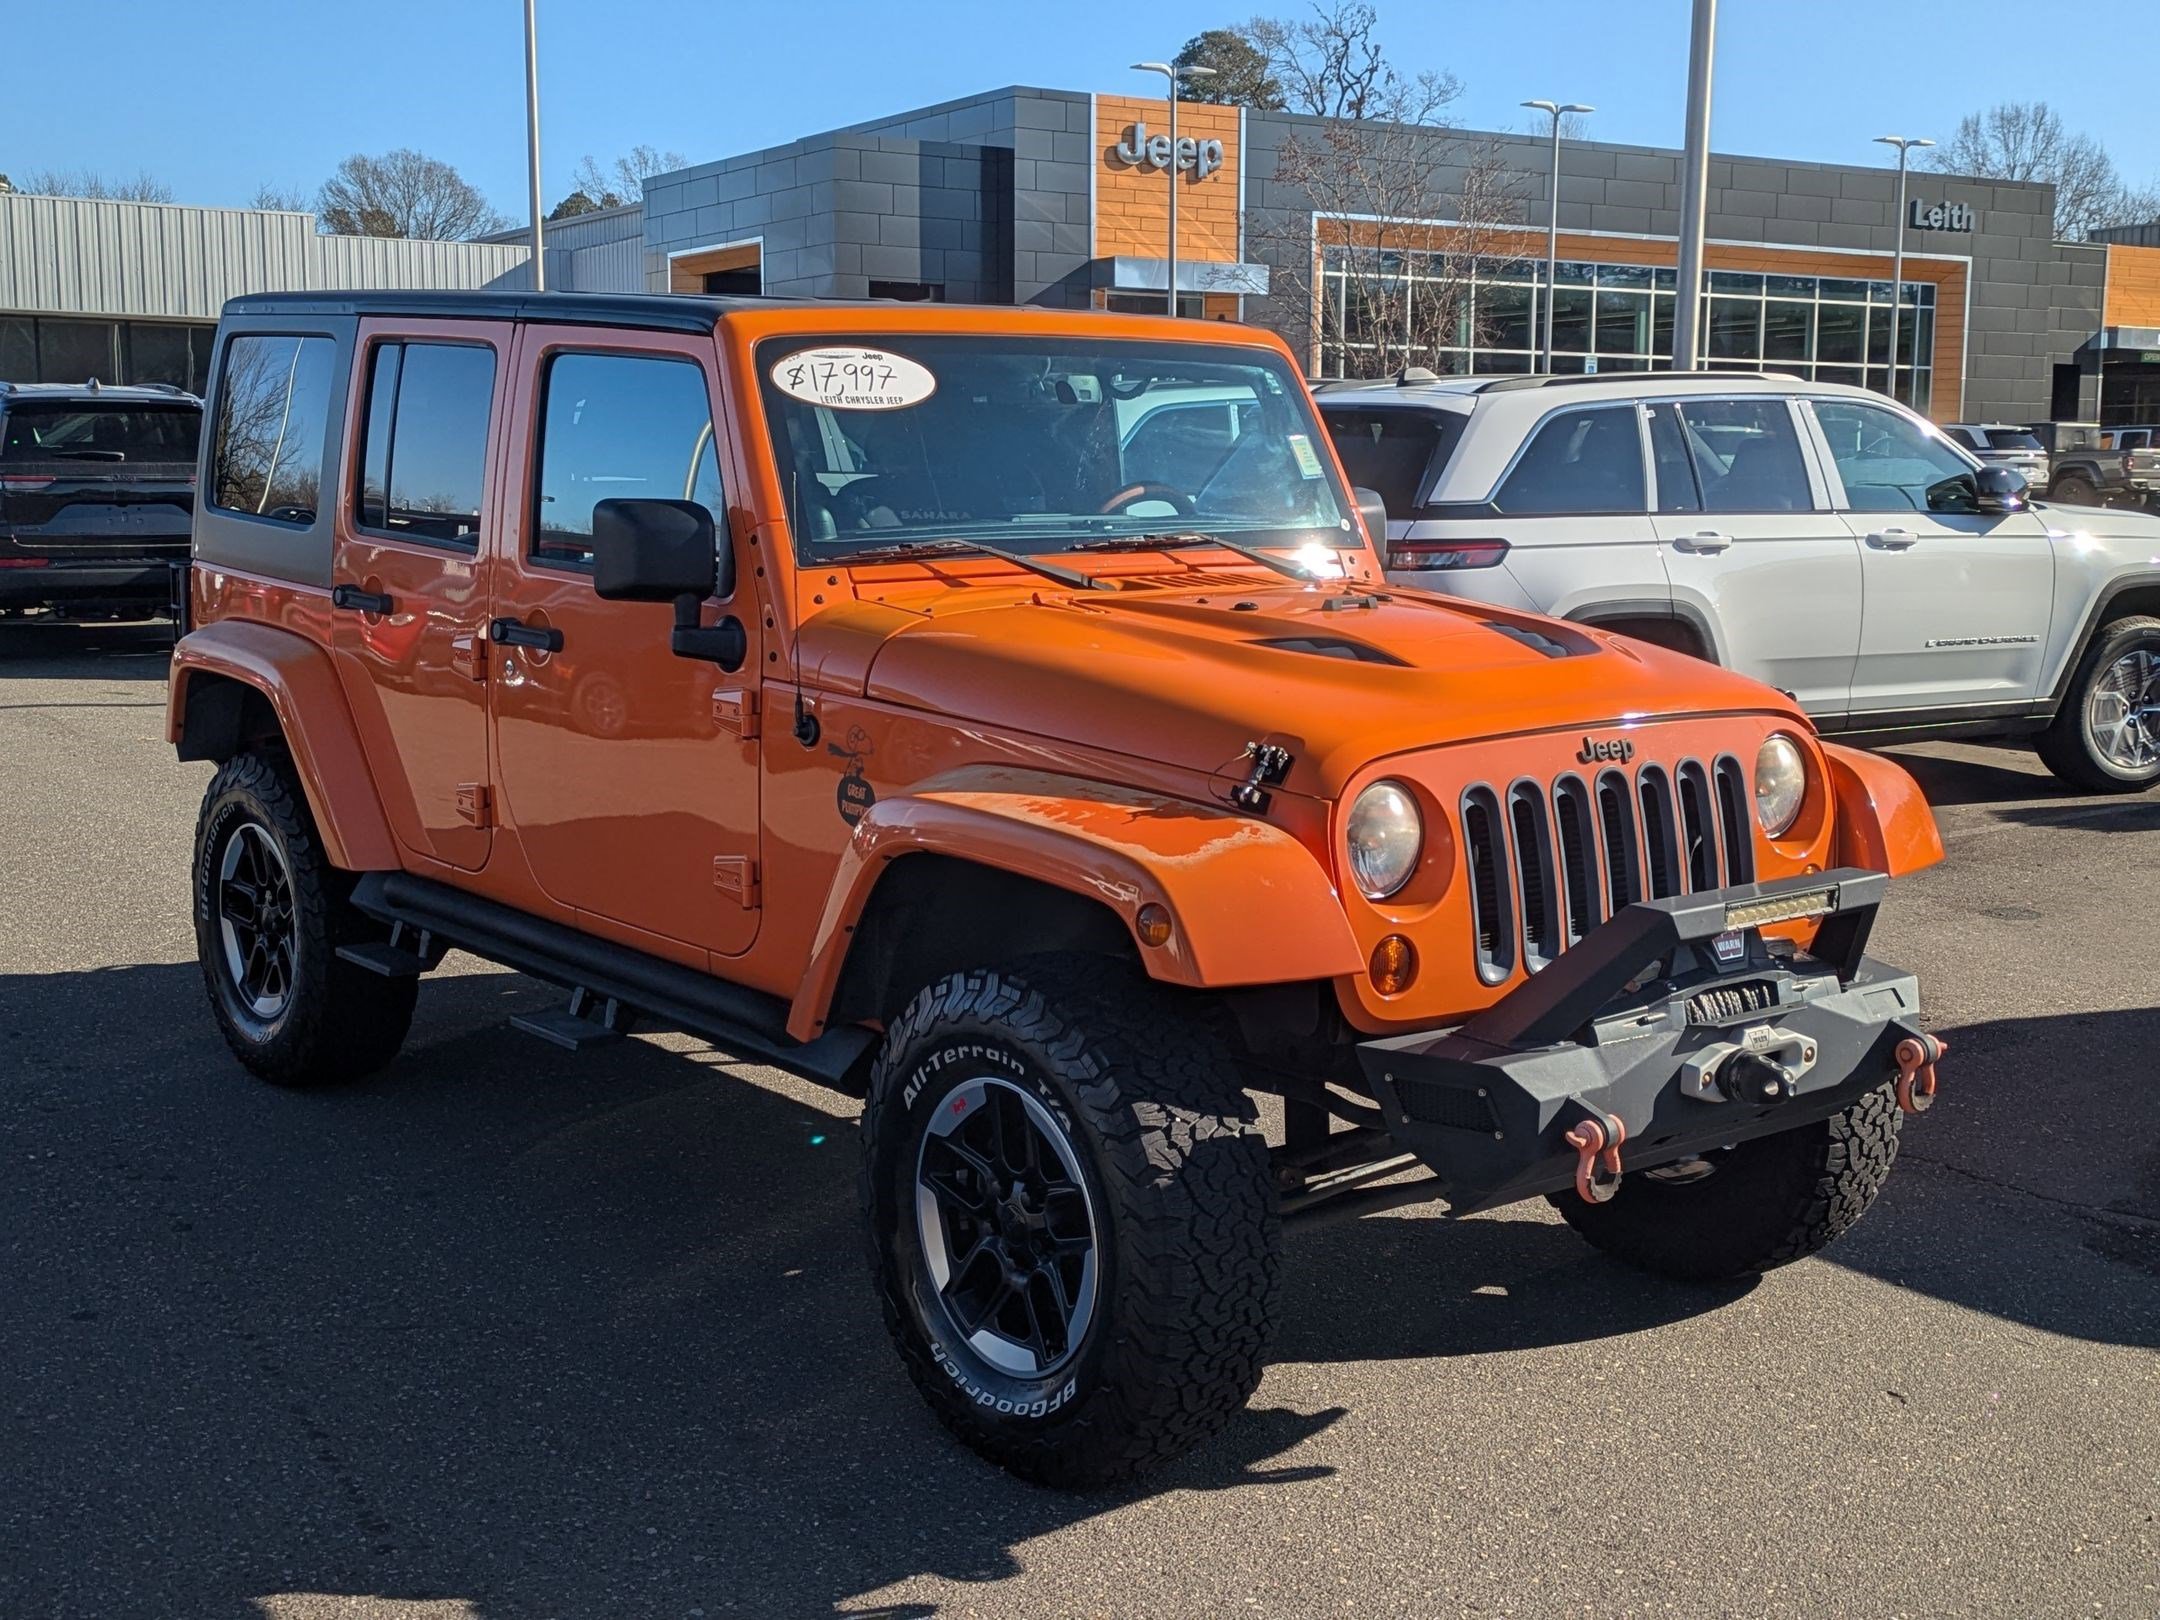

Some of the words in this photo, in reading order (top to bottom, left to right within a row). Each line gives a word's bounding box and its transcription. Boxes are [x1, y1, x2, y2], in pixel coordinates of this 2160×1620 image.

[1117, 122, 1224, 179] Jeep
[1915, 198, 1976, 230] Leith
[862, 352, 884, 361] Jeep
[787, 362, 898, 396] $17,997
[819, 395, 843, 405] LEITH
[844, 395, 885, 405] CHRYSLER
[886, 396, 904, 405] JEEP
[900, 510, 973, 520] SAHARA
[1580, 736, 1635, 764] Jeep
[848, 783, 867, 800] GREAT
[201, 801, 236, 921] BFGoodrich
[1716, 938, 1741, 952] WARN
[1038, 1077, 1072, 1133] T/A
[930, 1342, 1076, 1418] BFGoodrich
